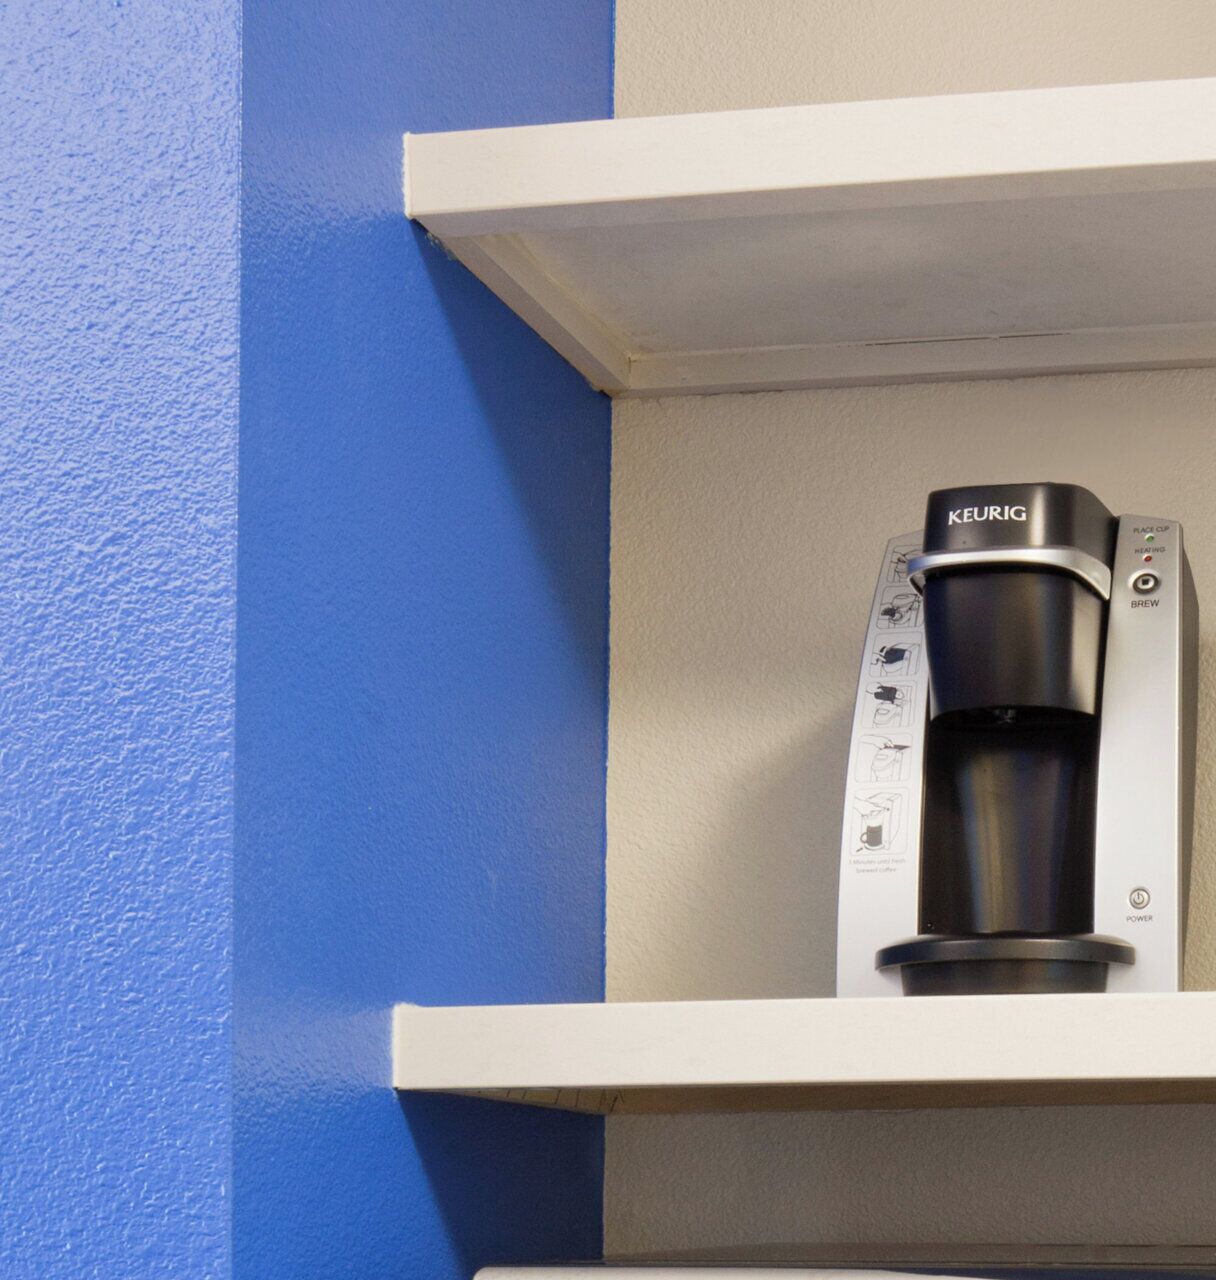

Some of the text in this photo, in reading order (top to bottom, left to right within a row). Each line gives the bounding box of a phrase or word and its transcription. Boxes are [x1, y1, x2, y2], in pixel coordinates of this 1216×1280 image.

[948, 505, 1027, 525] KEURIG
[1133, 525, 1170, 534] PLACE CUP
[1134, 546, 1166, 554] HEATING
[1131, 599, 1160, 609] BREW
[1126, 914, 1153, 923] POWER
